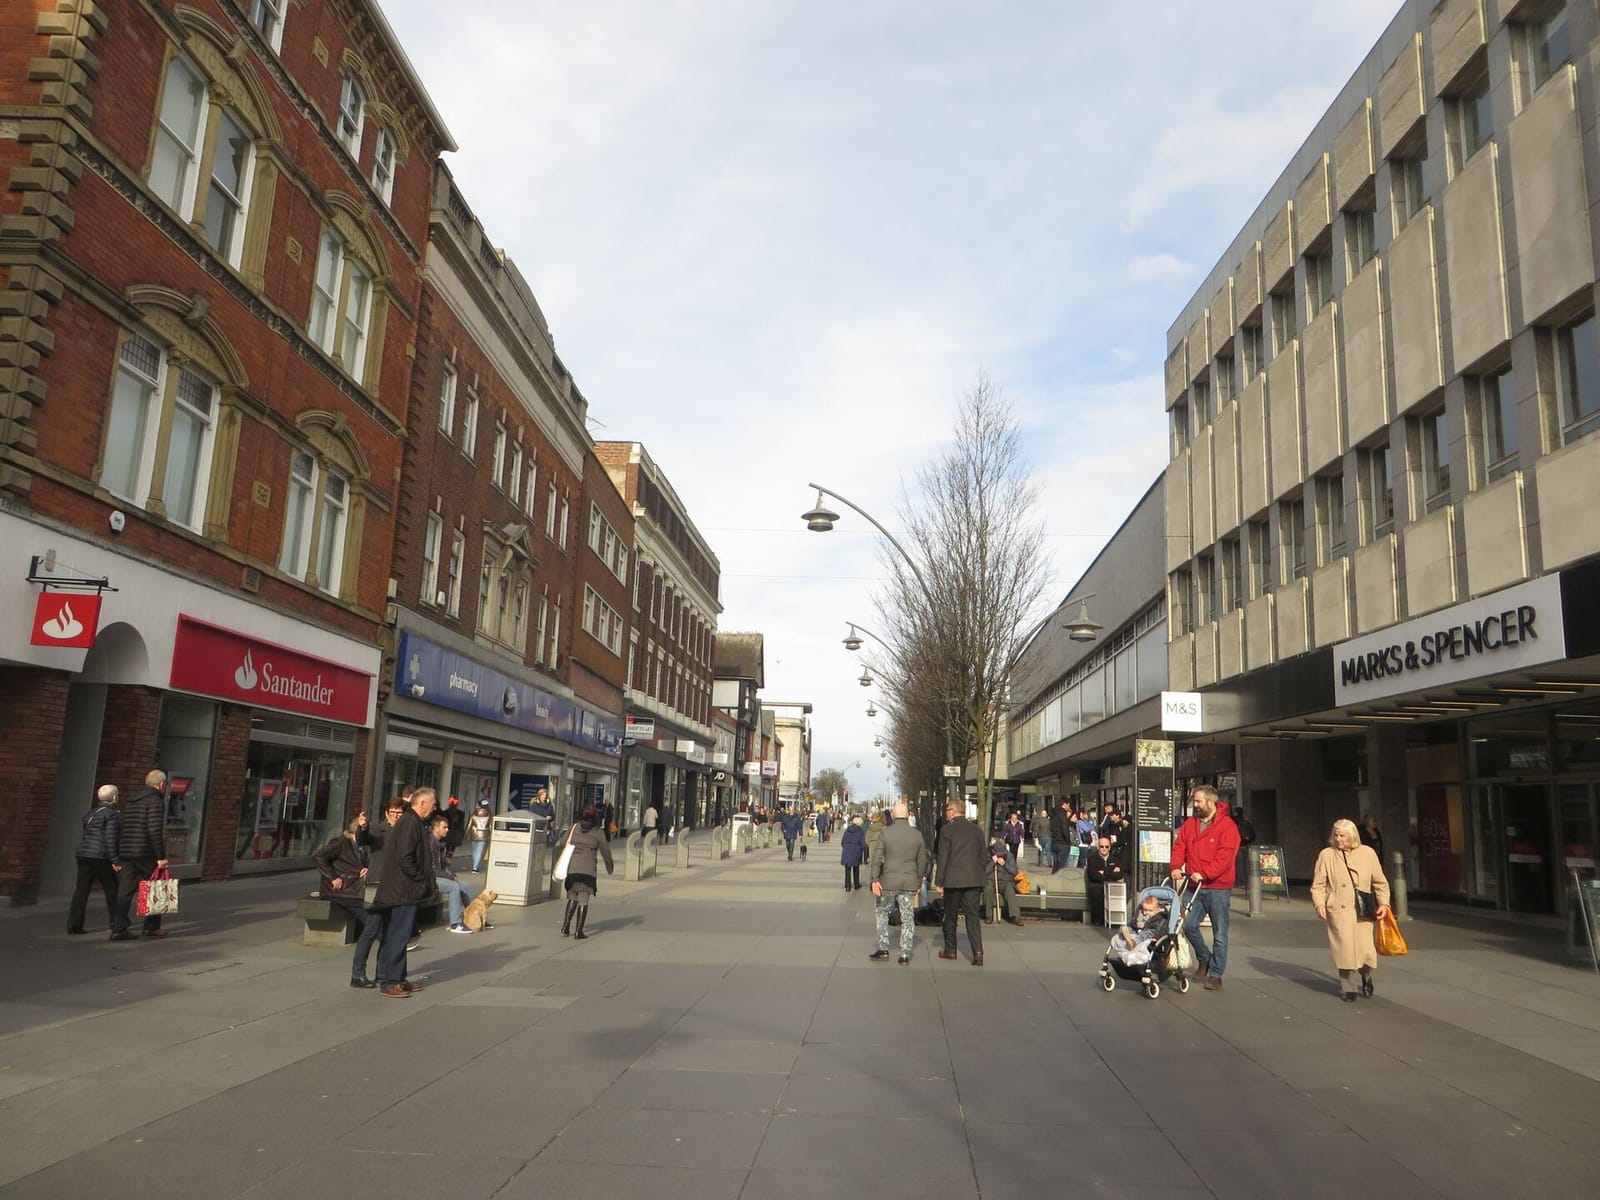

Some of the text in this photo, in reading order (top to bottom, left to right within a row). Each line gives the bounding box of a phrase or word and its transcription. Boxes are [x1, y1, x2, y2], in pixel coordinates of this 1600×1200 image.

[260, 662, 334, 706] Santander
[449, 672, 479, 697] pharmacy
[1166, 702, 1197, 716] M&S
[713, 772, 725, 780] JD
[1423, 839, 1449, 857] OFF
